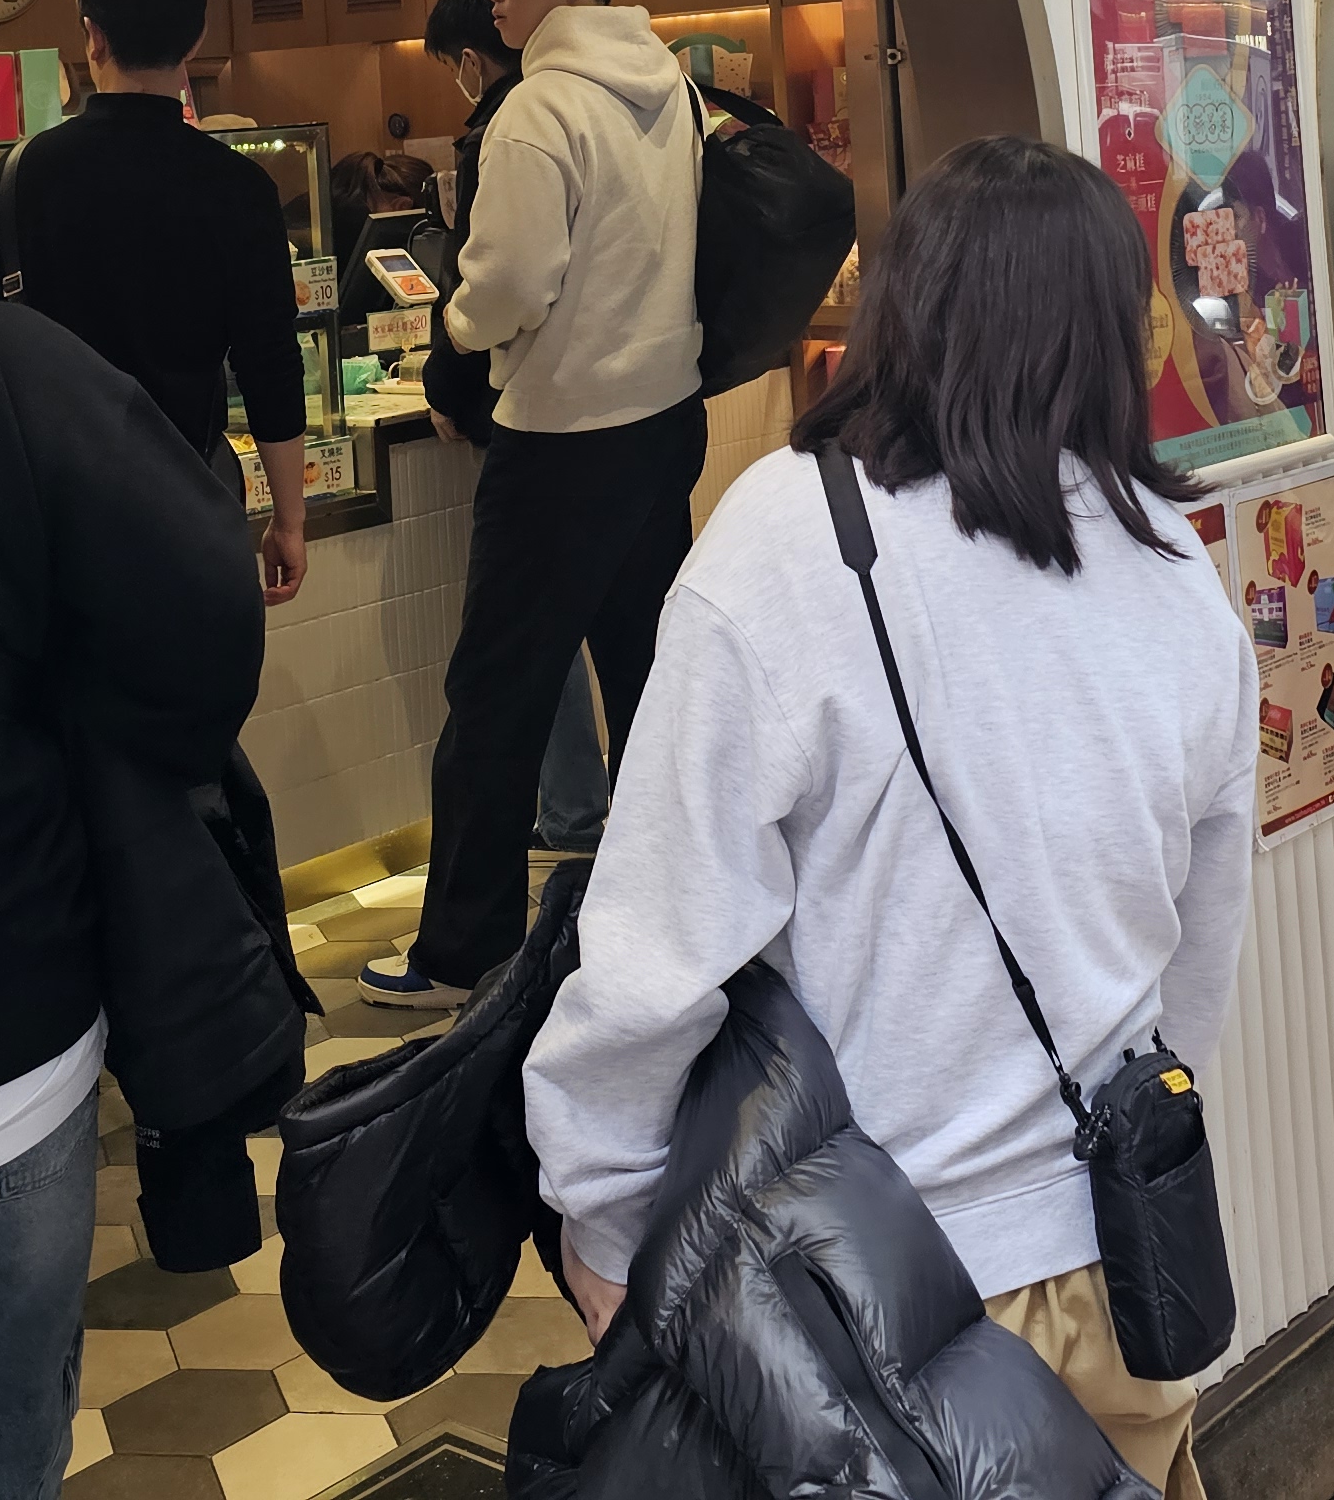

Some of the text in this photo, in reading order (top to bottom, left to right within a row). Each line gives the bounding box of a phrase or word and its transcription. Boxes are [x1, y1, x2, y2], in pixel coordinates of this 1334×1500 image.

[315, 284, 333, 300] $10
[410, 315, 427, 331] $20
[324, 466, 342, 482] $15
